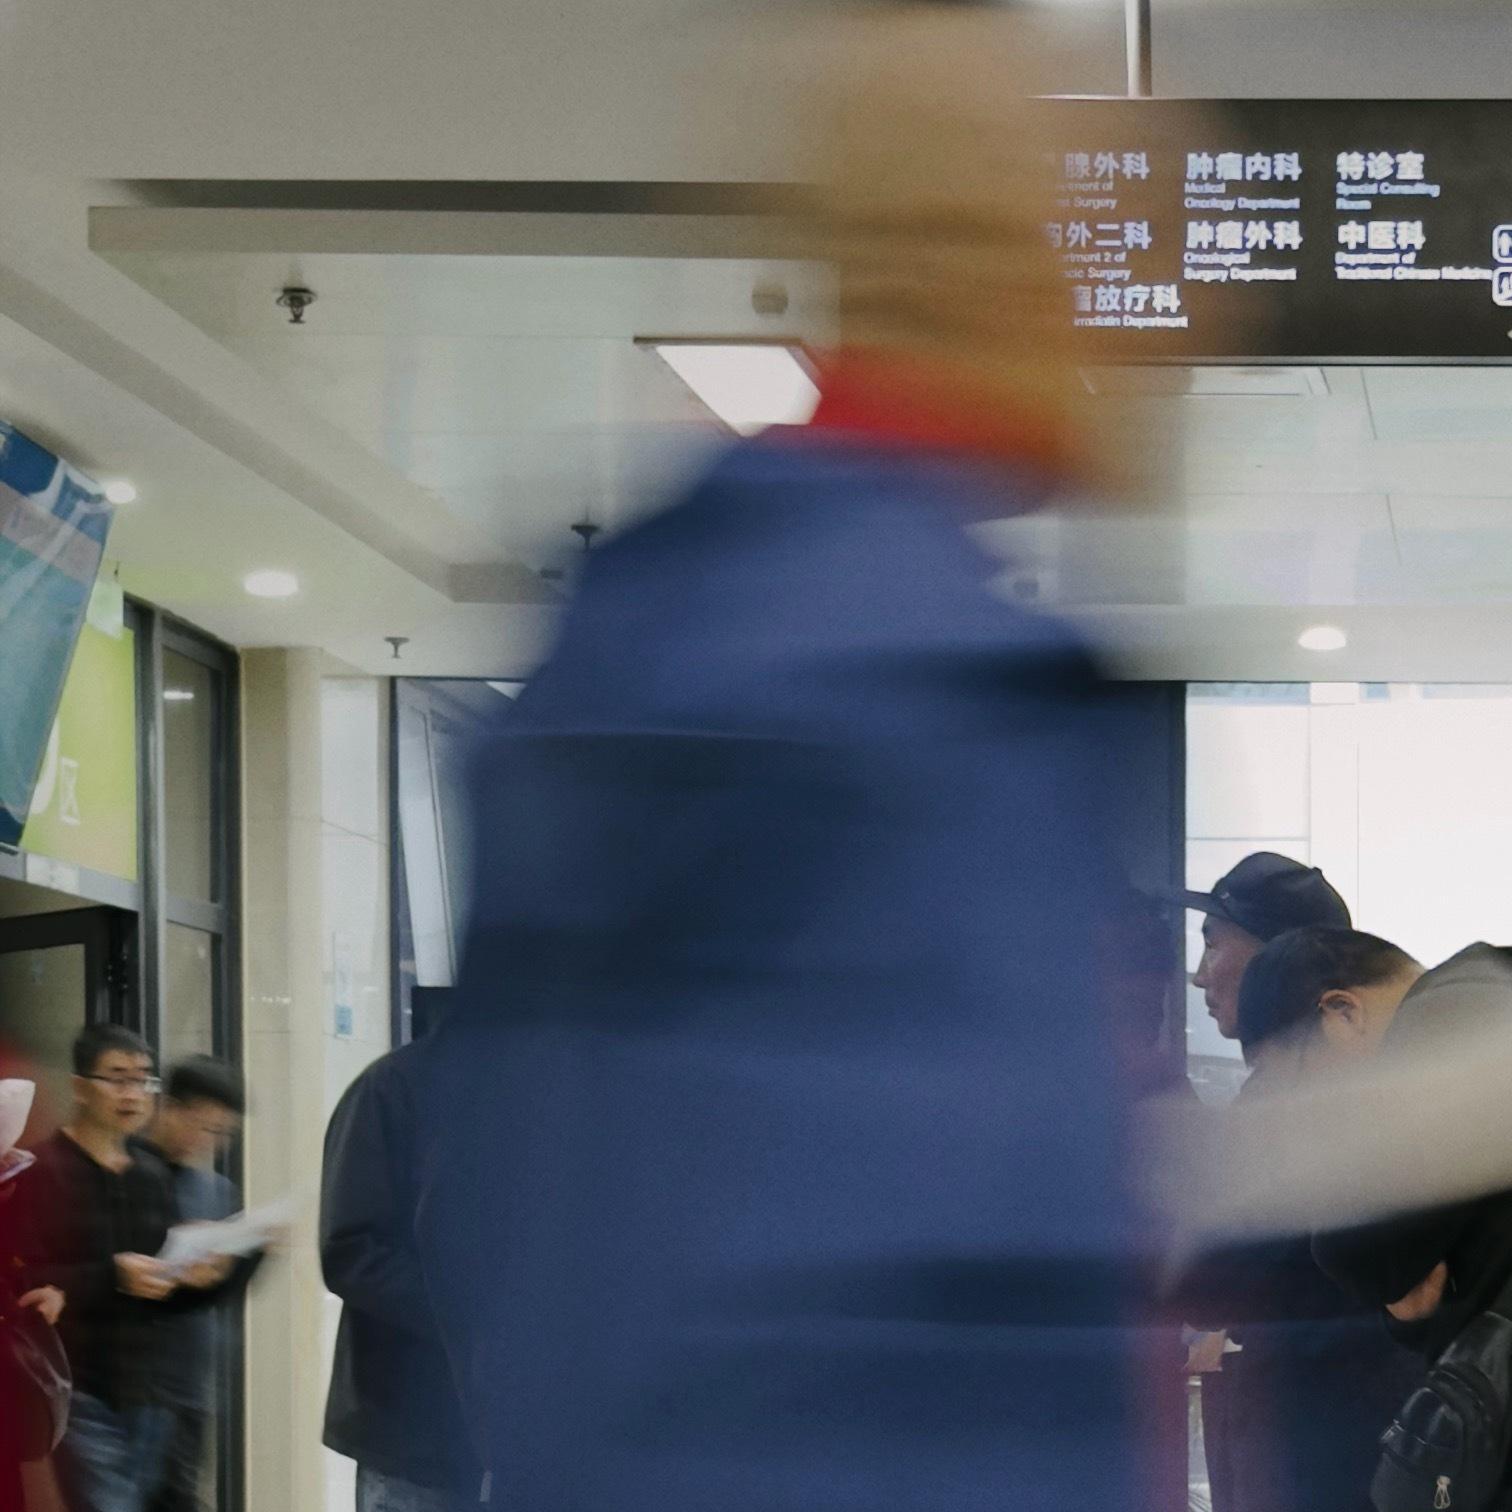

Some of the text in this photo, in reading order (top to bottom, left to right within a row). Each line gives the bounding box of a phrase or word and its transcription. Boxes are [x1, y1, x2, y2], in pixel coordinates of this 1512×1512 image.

[1044, 152, 1150, 180] 腺外科
[1186, 152, 1302, 181] 肿瘤内科
[1186, 220, 1303, 250] 肿瘤外科
[1338, 220, 1426, 250] 中医科
